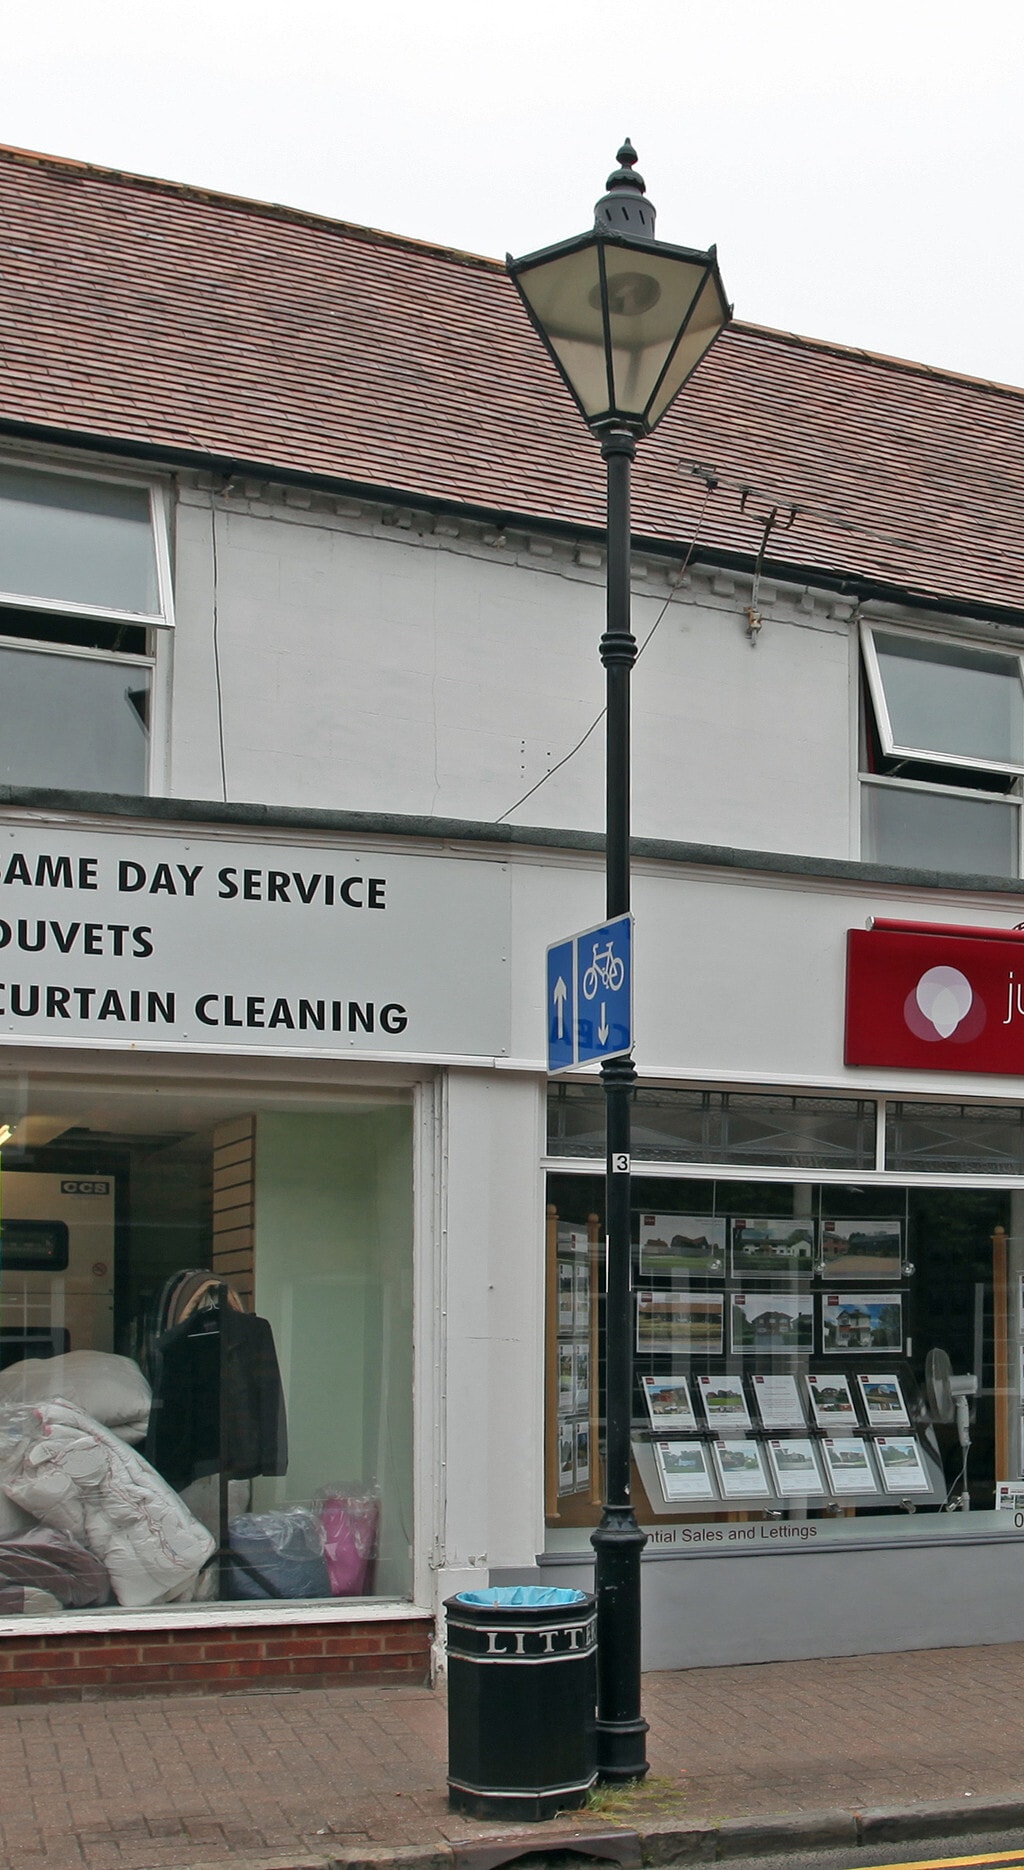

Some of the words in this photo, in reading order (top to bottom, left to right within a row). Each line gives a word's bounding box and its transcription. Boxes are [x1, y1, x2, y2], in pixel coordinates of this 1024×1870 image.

[0, 853, 98, 890] AME
[118, 859, 204, 897] DAY
[218, 867, 387, 910] SERVICE
[0, 983, 176, 1024] URTAIN
[194, 993, 409, 1035] CLEANING
[617, 1155, 628, 1171] 3
[63, 1182, 107, 1194] CCS
[681, 1527, 724, 1543] Sales
[728, 1526, 756, 1541] and
[761, 1525, 818, 1542] Lettings
